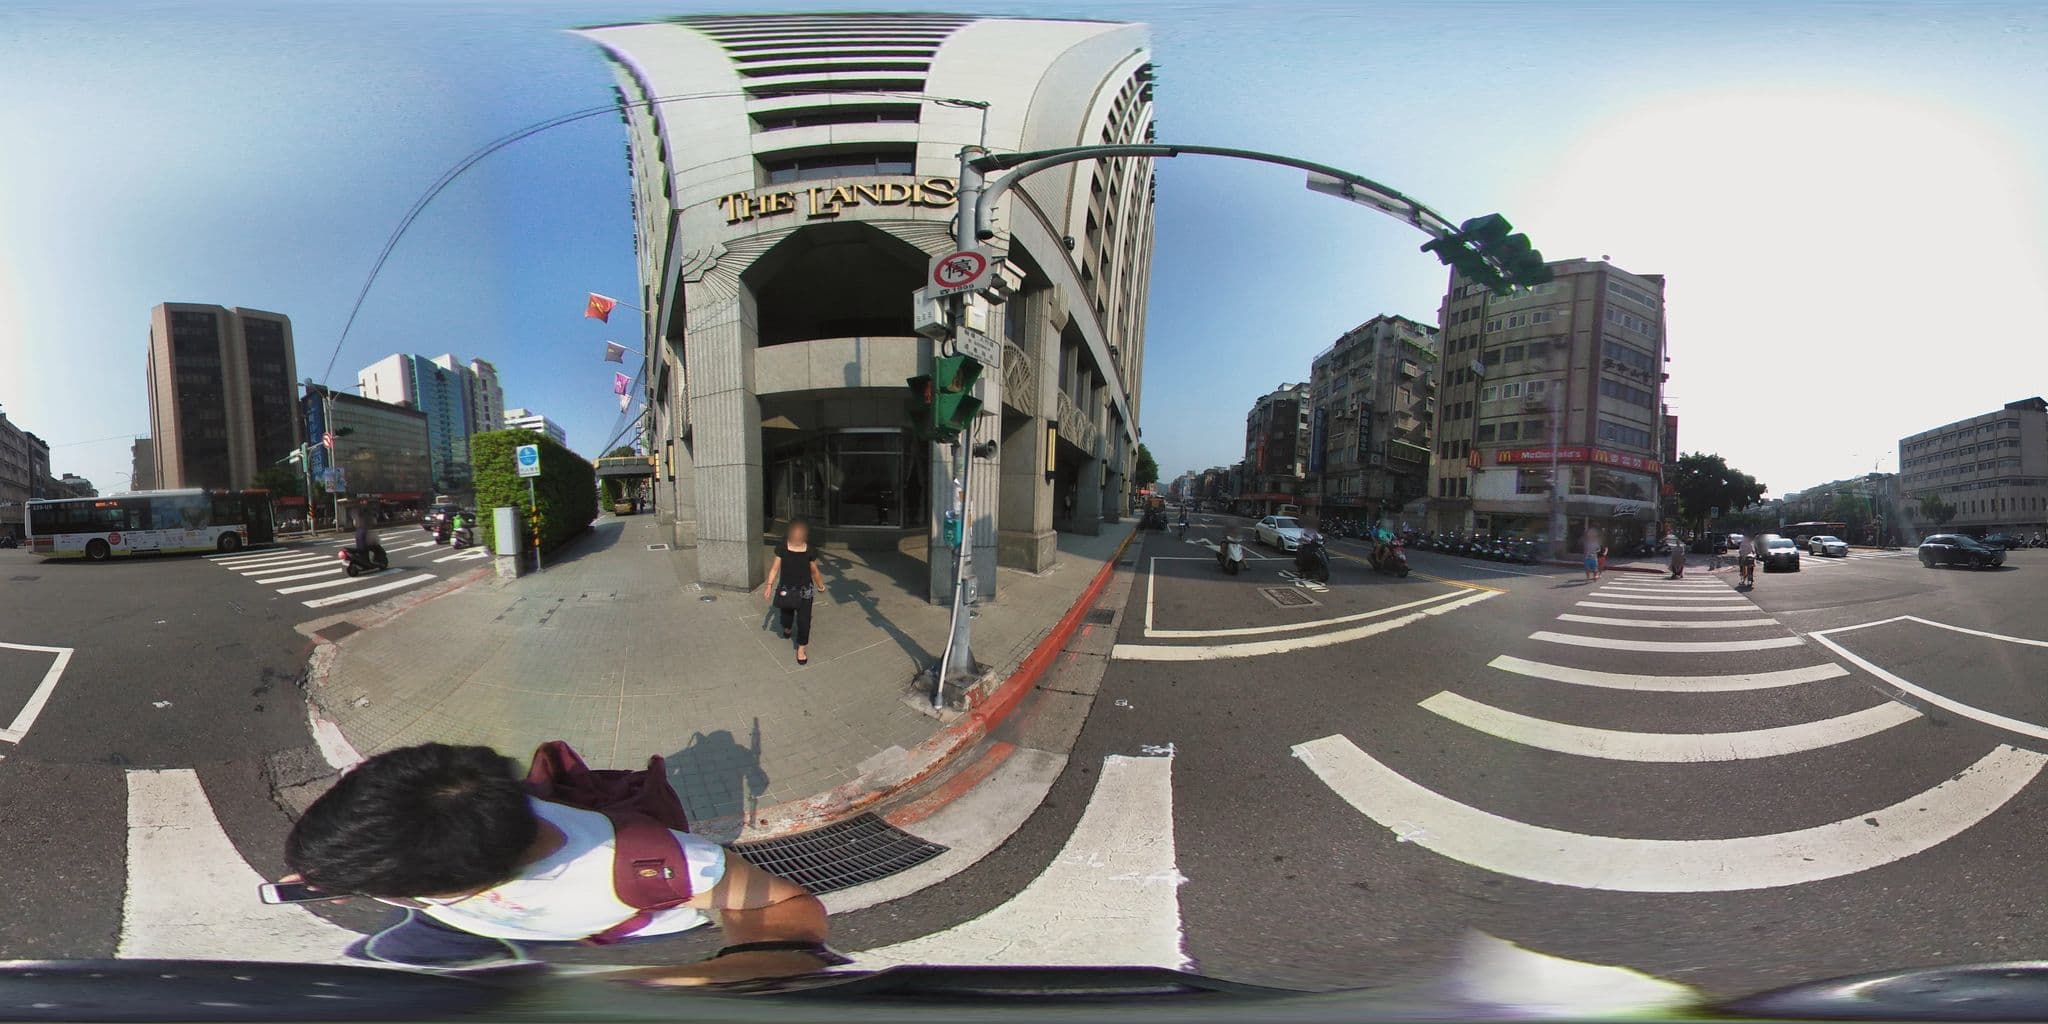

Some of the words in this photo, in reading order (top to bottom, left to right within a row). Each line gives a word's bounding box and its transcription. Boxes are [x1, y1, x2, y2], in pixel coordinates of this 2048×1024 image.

[718, 191, 796, 225] THE
[807, 177, 958, 219] LANDIS
[944, 258, 972, 279] 停
